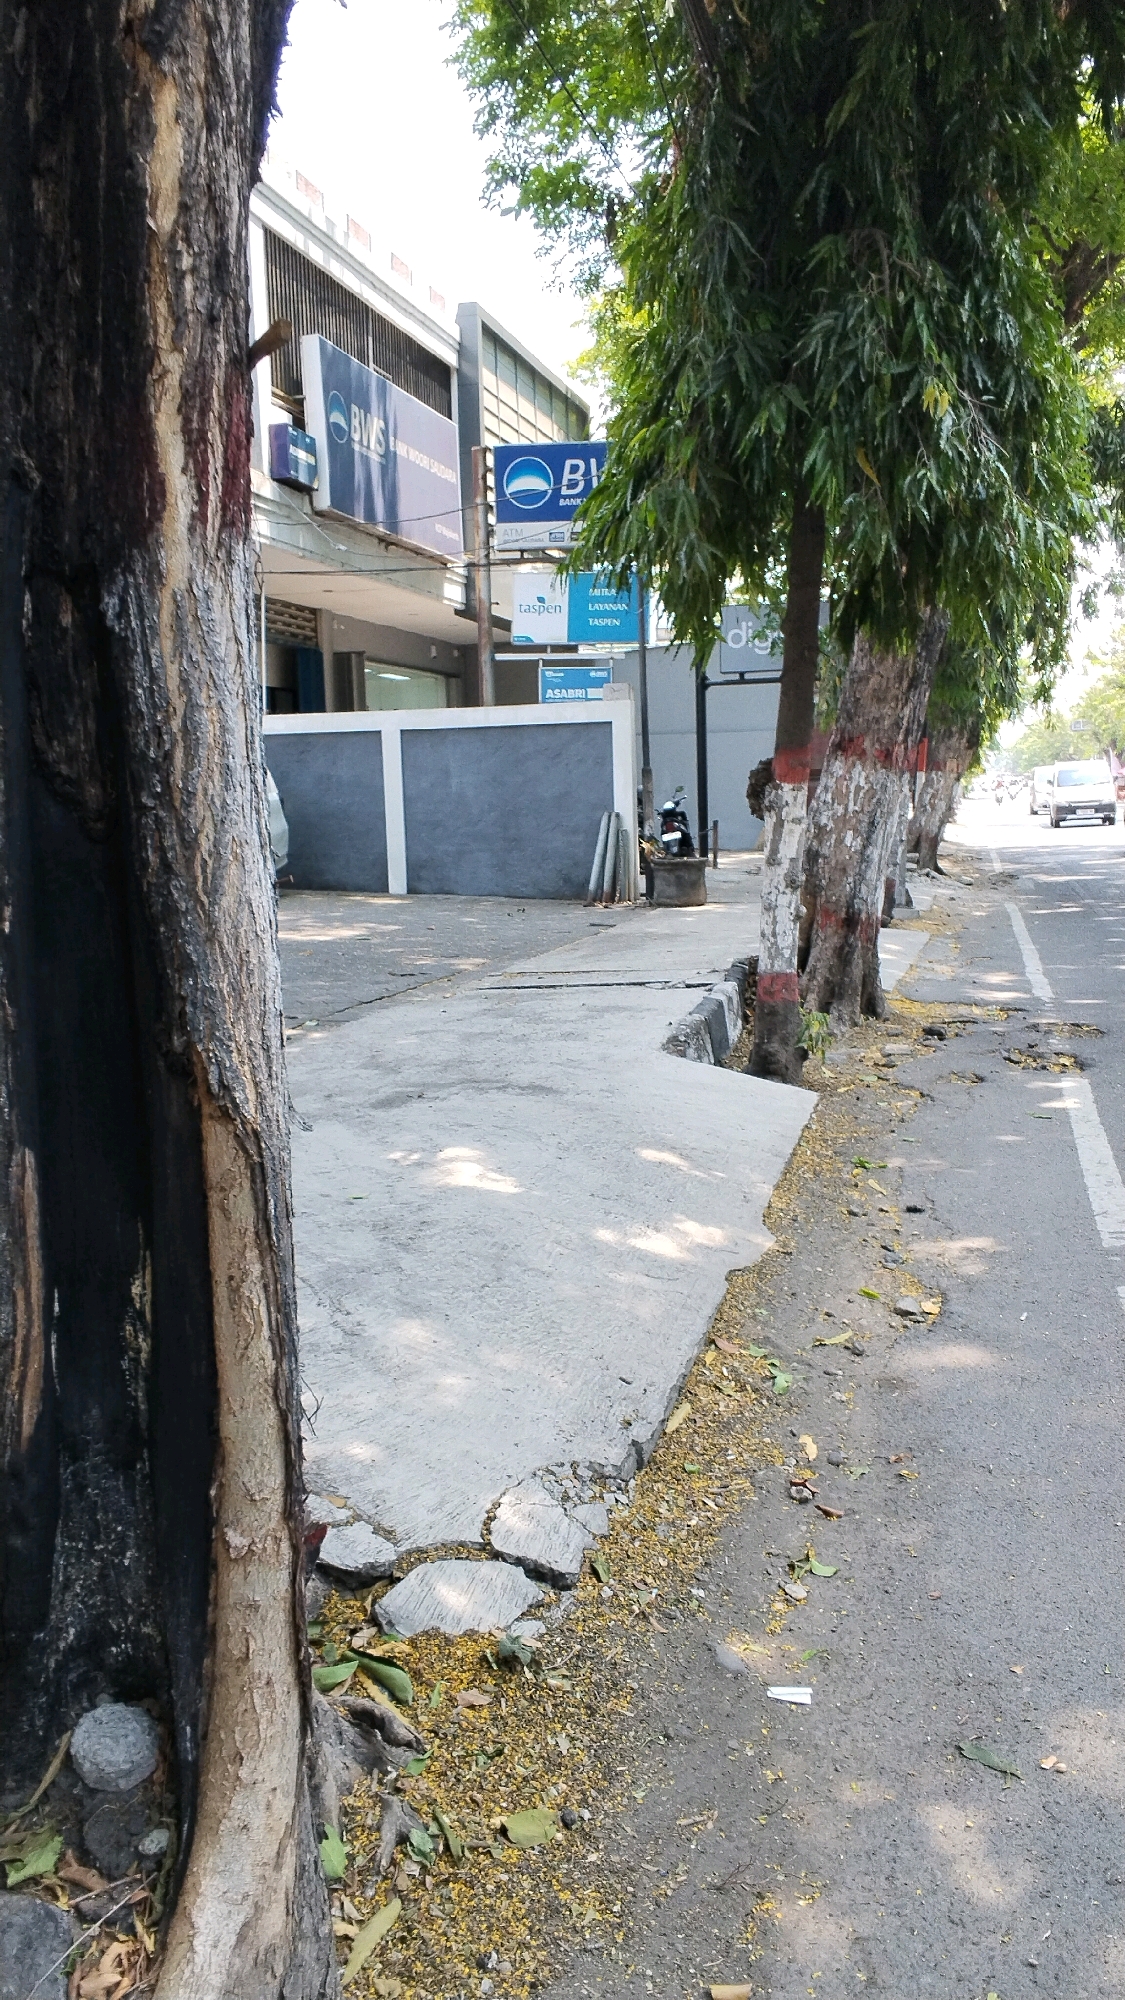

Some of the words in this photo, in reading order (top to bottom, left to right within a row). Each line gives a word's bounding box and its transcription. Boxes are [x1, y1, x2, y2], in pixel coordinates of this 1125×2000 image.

[350, 403, 386, 456] BWS
[559, 497, 582, 506] BANK
[502, 528, 524, 538] ATM
[519, 603, 562, 616] taspen
[588, 603, 629, 611] LAYANAN
[588, 618, 621, 627] TASPEN
[545, 688, 586, 699] ASABRI
